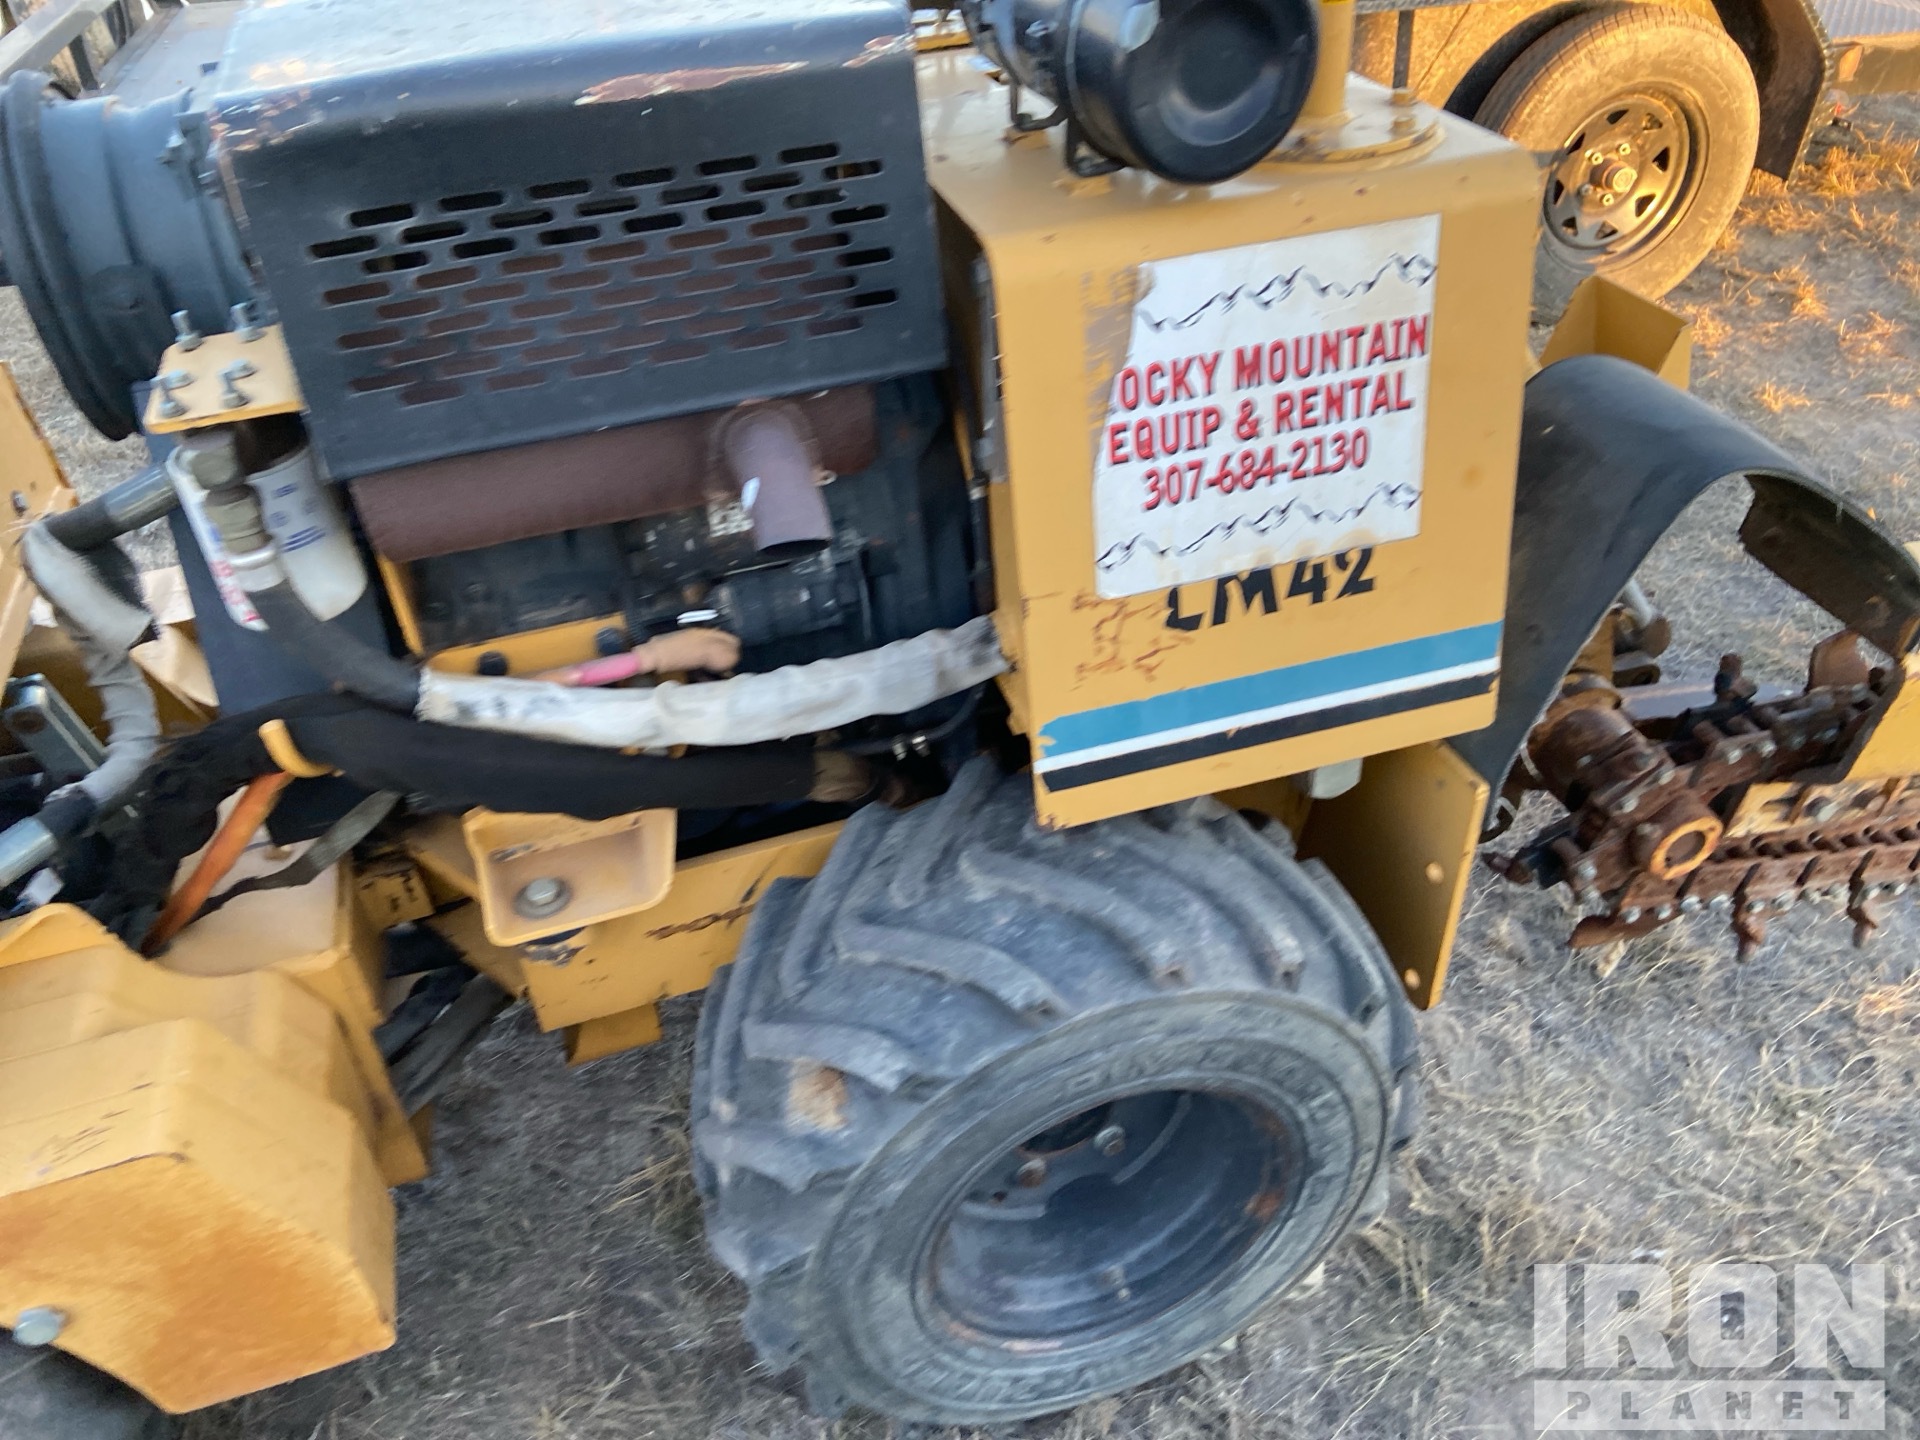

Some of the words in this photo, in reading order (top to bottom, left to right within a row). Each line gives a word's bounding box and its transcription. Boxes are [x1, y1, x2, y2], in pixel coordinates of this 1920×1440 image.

[1113, 349, 1222, 411] OCKY
[1233, 313, 1431, 391] MOUNTAIN
[1107, 404, 1222, 466] EQUIP
[1234, 397, 1261, 442] &
[1272, 369, 1414, 434] RENTAL
[1142, 427, 1370, 512] 307-684-2130
